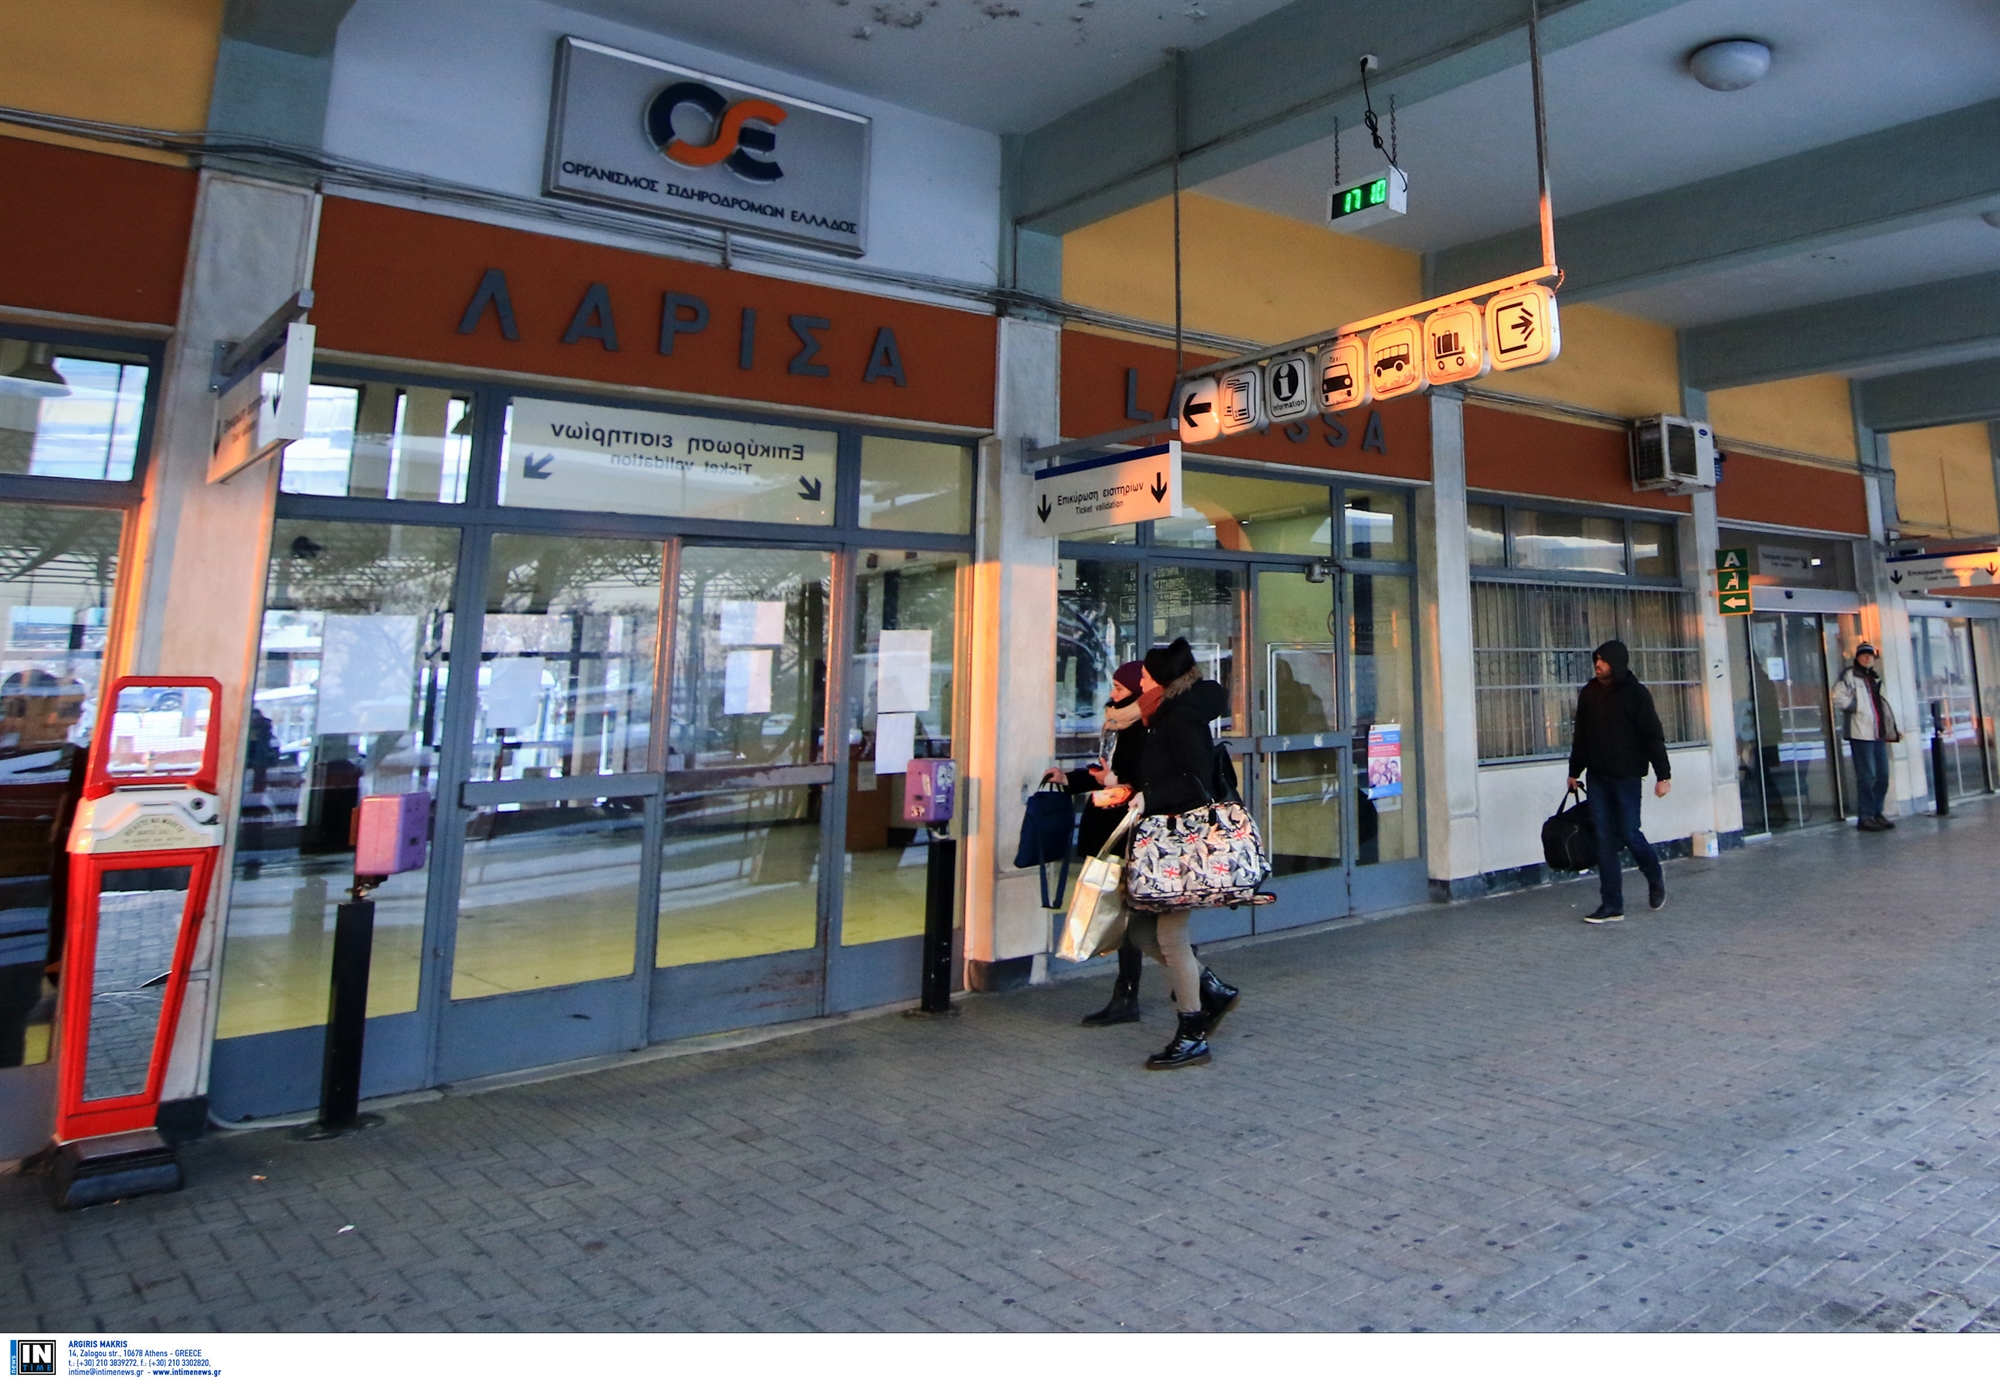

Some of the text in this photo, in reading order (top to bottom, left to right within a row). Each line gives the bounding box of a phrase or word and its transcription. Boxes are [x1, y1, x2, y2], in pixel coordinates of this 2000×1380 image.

[562, 161, 857, 234] ΟΡΓΑΝΙΣΜΟΣ ΣΙΔΗΡΟΔΡΟΜΩΝ ΕΛΛΑΔΟΣ
[456, 267, 907, 387] ΛΑΡΙΣΑ
[1057, 481, 1144, 506] Επικύρωση εισιτηρίων
[1075, 500, 1124, 515] Ticket validation
[1723, 551, 1741, 568] A
